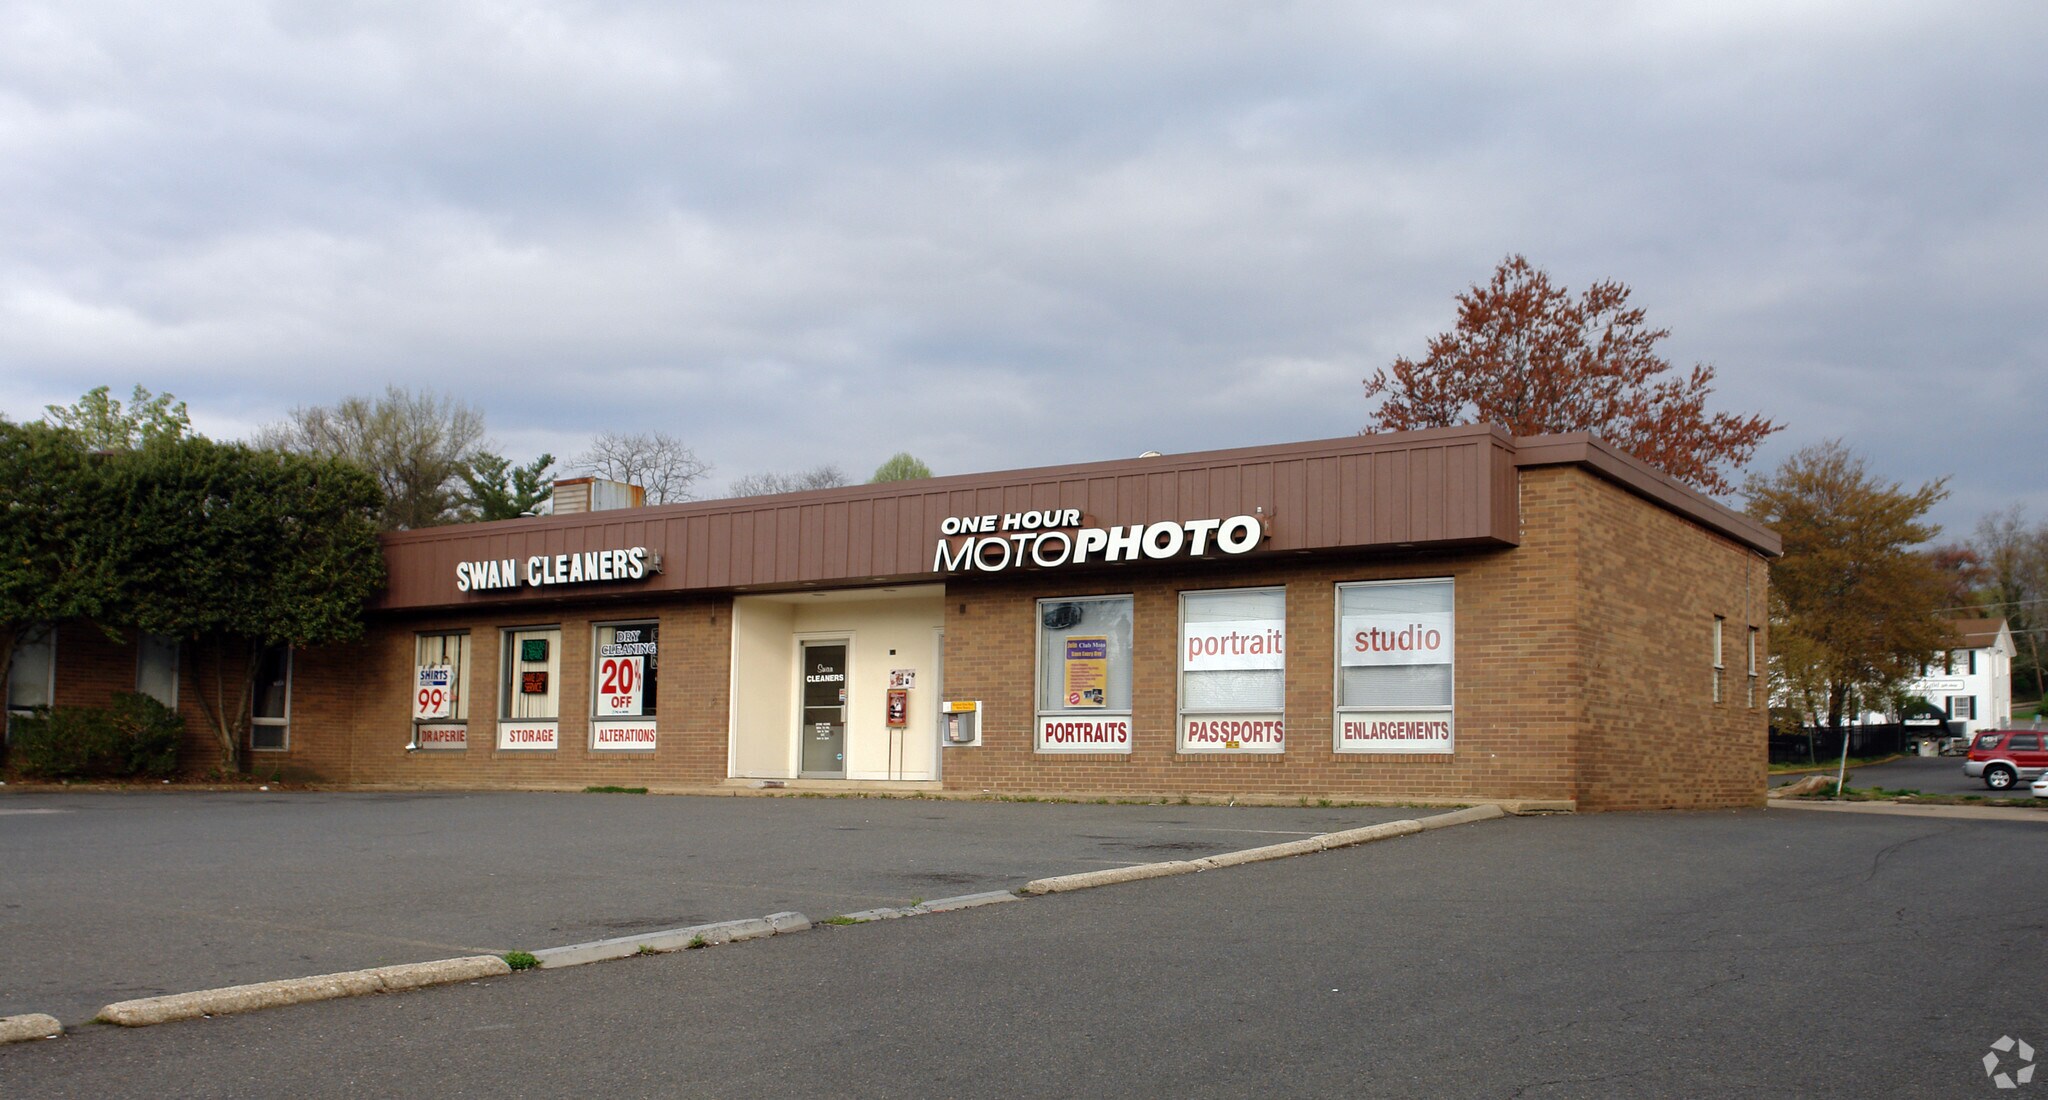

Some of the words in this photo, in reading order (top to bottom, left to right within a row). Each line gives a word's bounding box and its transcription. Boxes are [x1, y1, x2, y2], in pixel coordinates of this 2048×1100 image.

[940, 514, 998, 536] ONE
[1002, 508, 1081, 531] HOUR
[456, 558, 517, 592] SWAN
[527, 546, 645, 587] CLEANERS
[616, 630, 641, 643] DRY
[1188, 628, 1283, 662] portrait
[1355, 623, 1441, 652] studio
[601, 642, 656, 656] CLEANING
[420, 670, 448, 680] SHIRTS
[600, 658, 641, 695] 20%
[806, 674, 844, 683] CLEANERS
[611, 696, 632, 708] OFF
[509, 729, 554, 742] STORAGE
[599, 728, 655, 742] ALTERATIONS
[1045, 722, 1127, 743] PORTRAITS
[1188, 720, 1284, 743] PASSPORTS
[1344, 721, 1449, 740] ENLARGEMENTS
